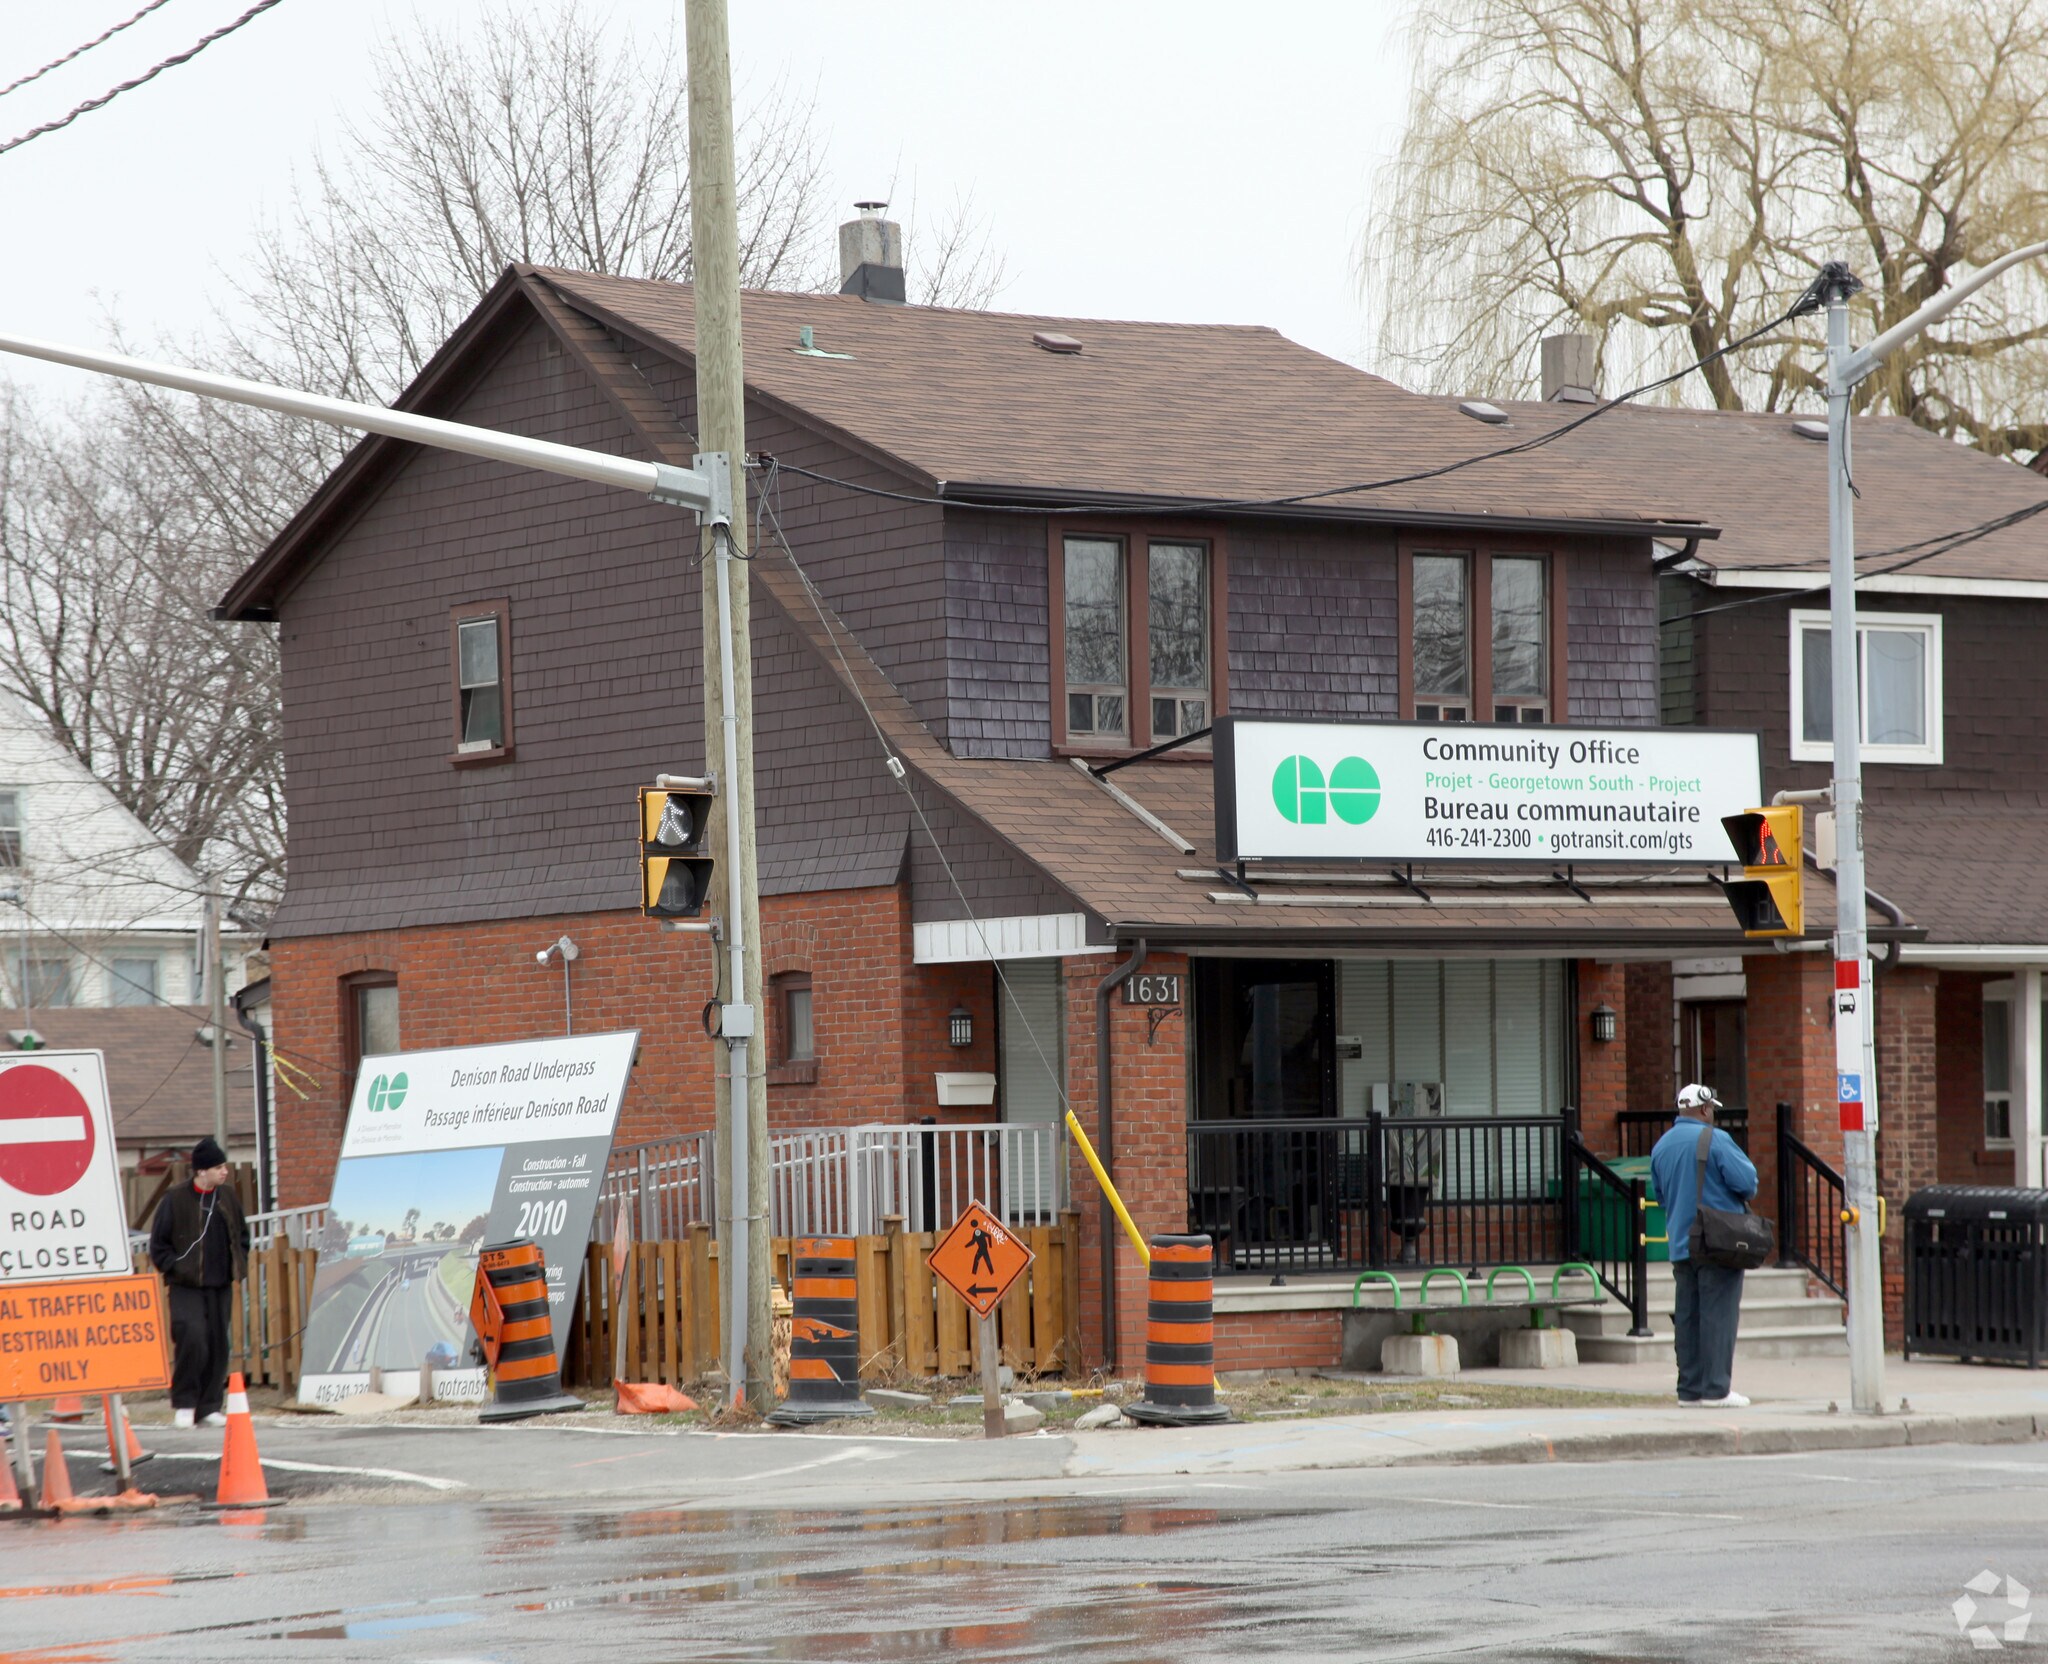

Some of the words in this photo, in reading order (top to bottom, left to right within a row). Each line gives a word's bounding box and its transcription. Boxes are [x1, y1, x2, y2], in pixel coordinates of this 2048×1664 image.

[1423, 737, 1560, 770] Community
[1569, 739, 1640, 764] Office
[1425, 771, 1473, 793] Projet
[1488, 773, 1584, 794] Georgetown
[1589, 775, 1634, 791] South
[1649, 776, 1702, 797] Project
[1424, 796, 1509, 820] Bureau
[1517, 801, 1700, 823] communautaire
[1426, 828, 1532, 848] 416-241-2300
[1550, 829, 1693, 855] gotransit.com/gts
[1127, 976, 1179, 1002] 1631
[450, 1066, 497, 1088] Denison
[499, 1061, 531, 1083] Road
[533, 1059, 596, 1082] Underpass
[424, 1108, 469, 1130] Passage
[471, 1102, 524, 1123] inférieur
[525, 1097, 573, 1119] Denison
[575, 1092, 609, 1115] Road
[522, 1155, 566, 1171] Construction
[572, 1154, 587, 1168] Fall
[508, 1176, 552, 1193] Construction
[557, 1177, 590, 1189] automne
[11, 1208, 85, 1232] ROAD
[514, 1199, 567, 1237] 2010
[0, 1245, 108, 1271] CLOSED
[27, 1293, 106, 1319] TRAFFIC
[113, 1289, 151, 1313] AND
[85, 1321, 156, 1347] ACCESS
[39, 1359, 90, 1384] ONLY
